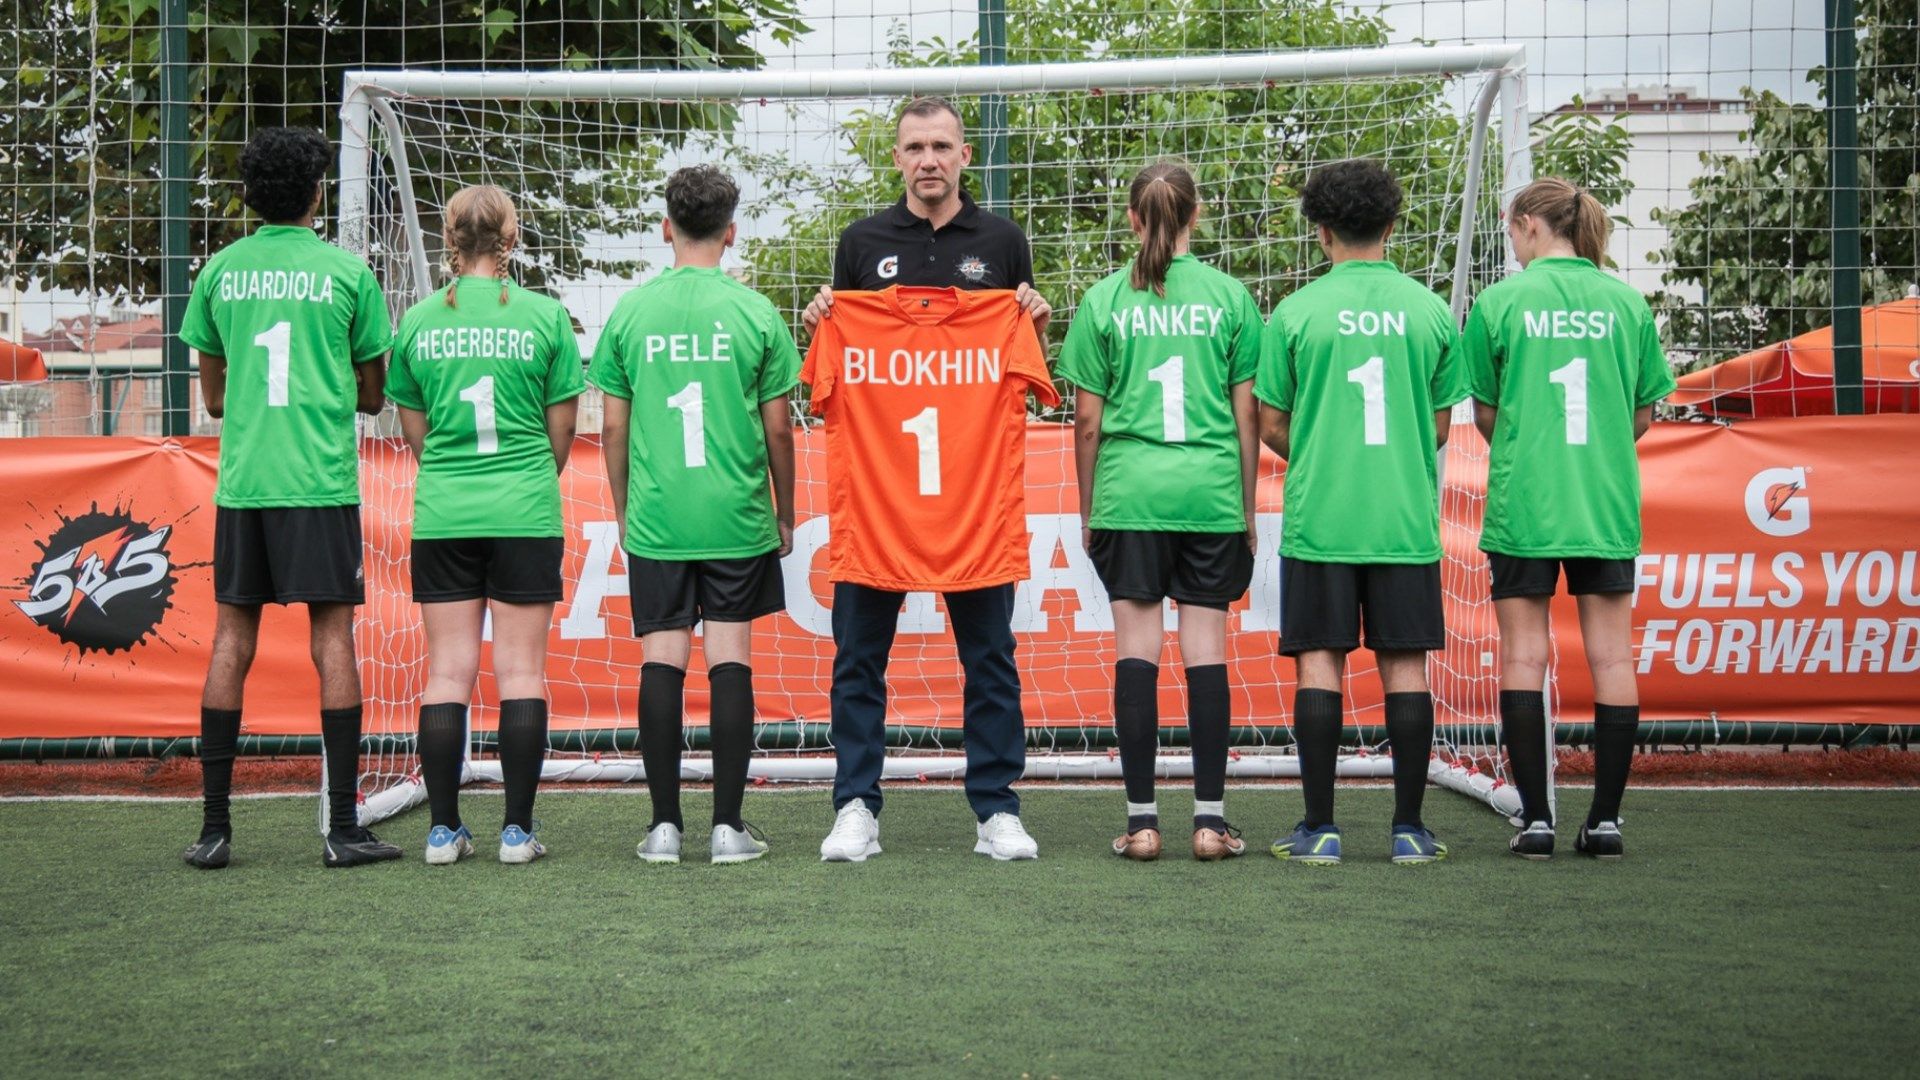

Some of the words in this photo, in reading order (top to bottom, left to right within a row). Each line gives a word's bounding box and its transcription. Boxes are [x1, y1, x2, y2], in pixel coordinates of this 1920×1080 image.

[221, 270, 333, 304] GUARDIOLA
[877, 255, 898, 279] G
[417, 328, 535, 361] HEGERBERG
[645, 321, 731, 363] PELÈ
[1111, 304, 1224, 340] YANKEY
[1337, 310, 1405, 336] SON
[1523, 310, 1615, 339] MESSI
[254, 321, 291, 407] 1
[844, 346, 1000, 386] BLOKHIN
[459, 375, 498, 454] 1
[666, 381, 706, 468] 1
[1148, 355, 1186, 442] 1
[1347, 356, 1386, 445] 1
[1549, 357, 1587, 445] 1
[902, 406, 941, 496] 1
[1744, 467, 1810, 537] G
[1631, 551, 1805, 608] FUELS
[1635, 617, 1920, 675] FORWARD
